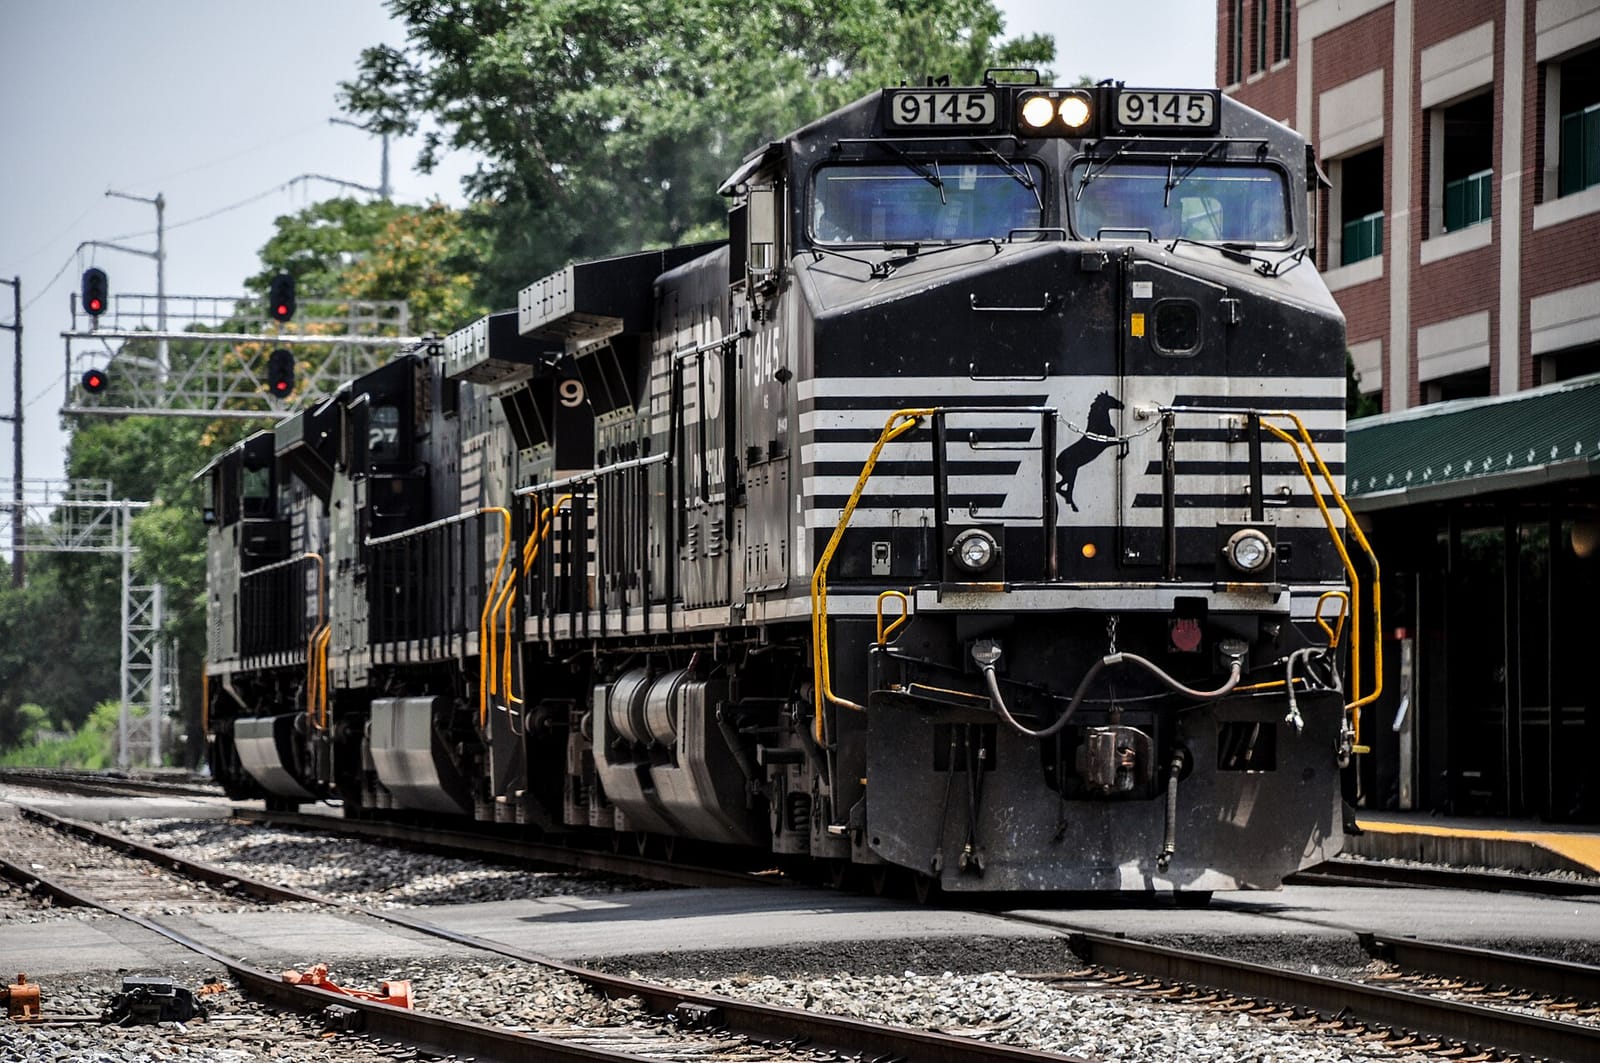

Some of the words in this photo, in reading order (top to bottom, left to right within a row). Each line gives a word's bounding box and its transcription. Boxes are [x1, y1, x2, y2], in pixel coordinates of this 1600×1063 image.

[900, 95, 986, 123] 9145
[1126, 95, 1205, 123] 9145
[754, 327, 779, 387] 9145
[560, 379, 584, 407] 9
